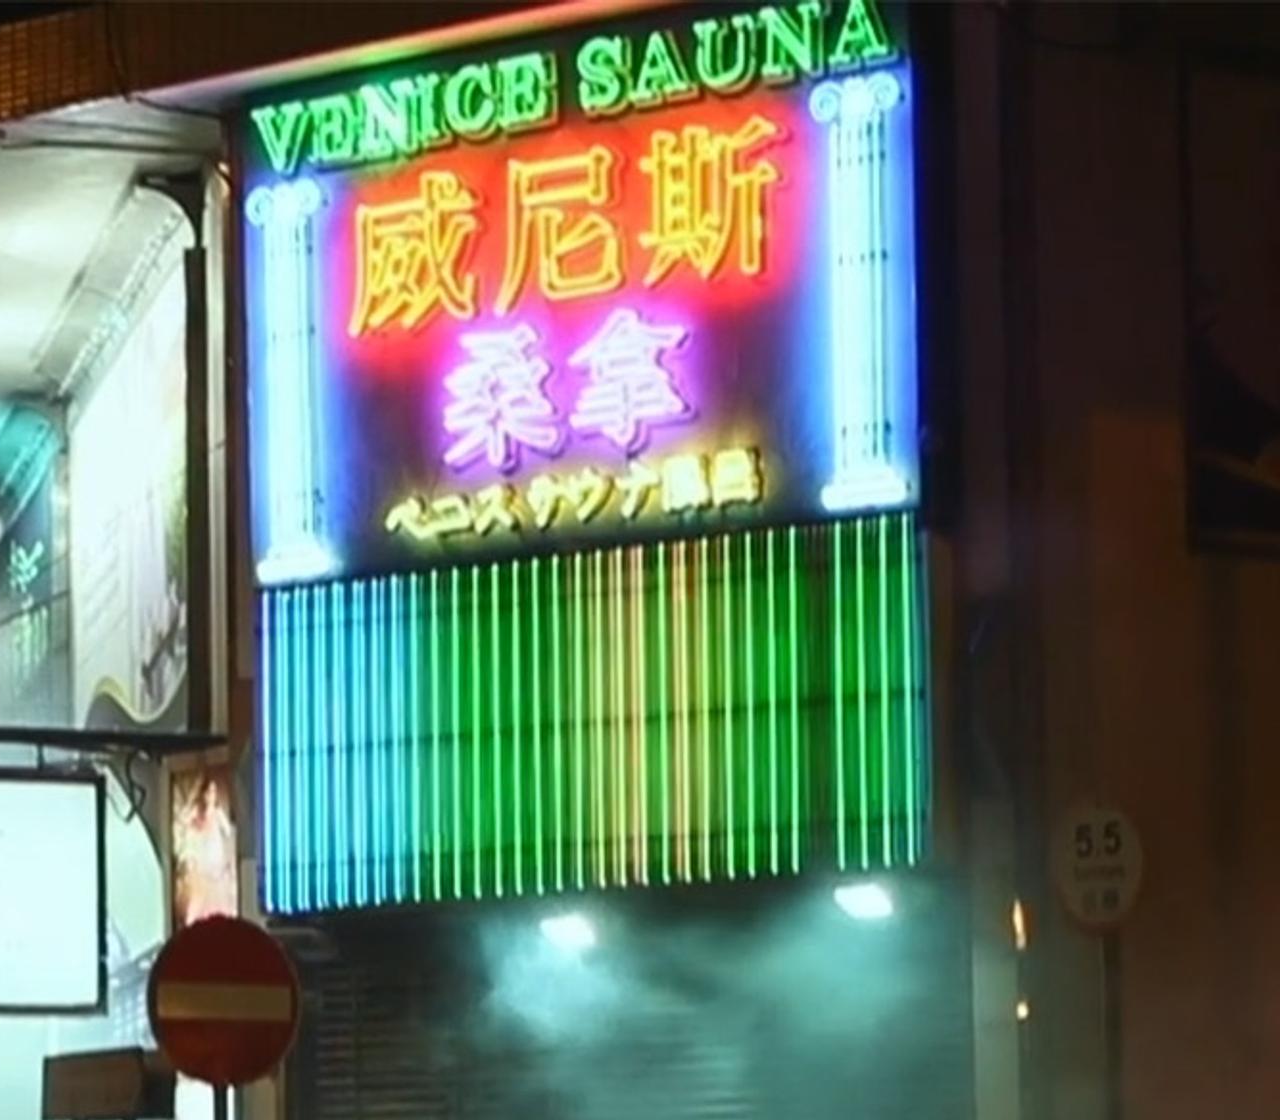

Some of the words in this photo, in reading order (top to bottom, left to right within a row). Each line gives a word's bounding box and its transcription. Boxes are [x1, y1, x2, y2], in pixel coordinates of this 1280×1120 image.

[251, 52, 556, 174] VENICE
[576, 0, 896, 112] SAUNA
[346, 115, 782, 338] 威尼斯
[443, 308, 690, 470] 桑拿
[1074, 819, 1122, 859] 5.5
